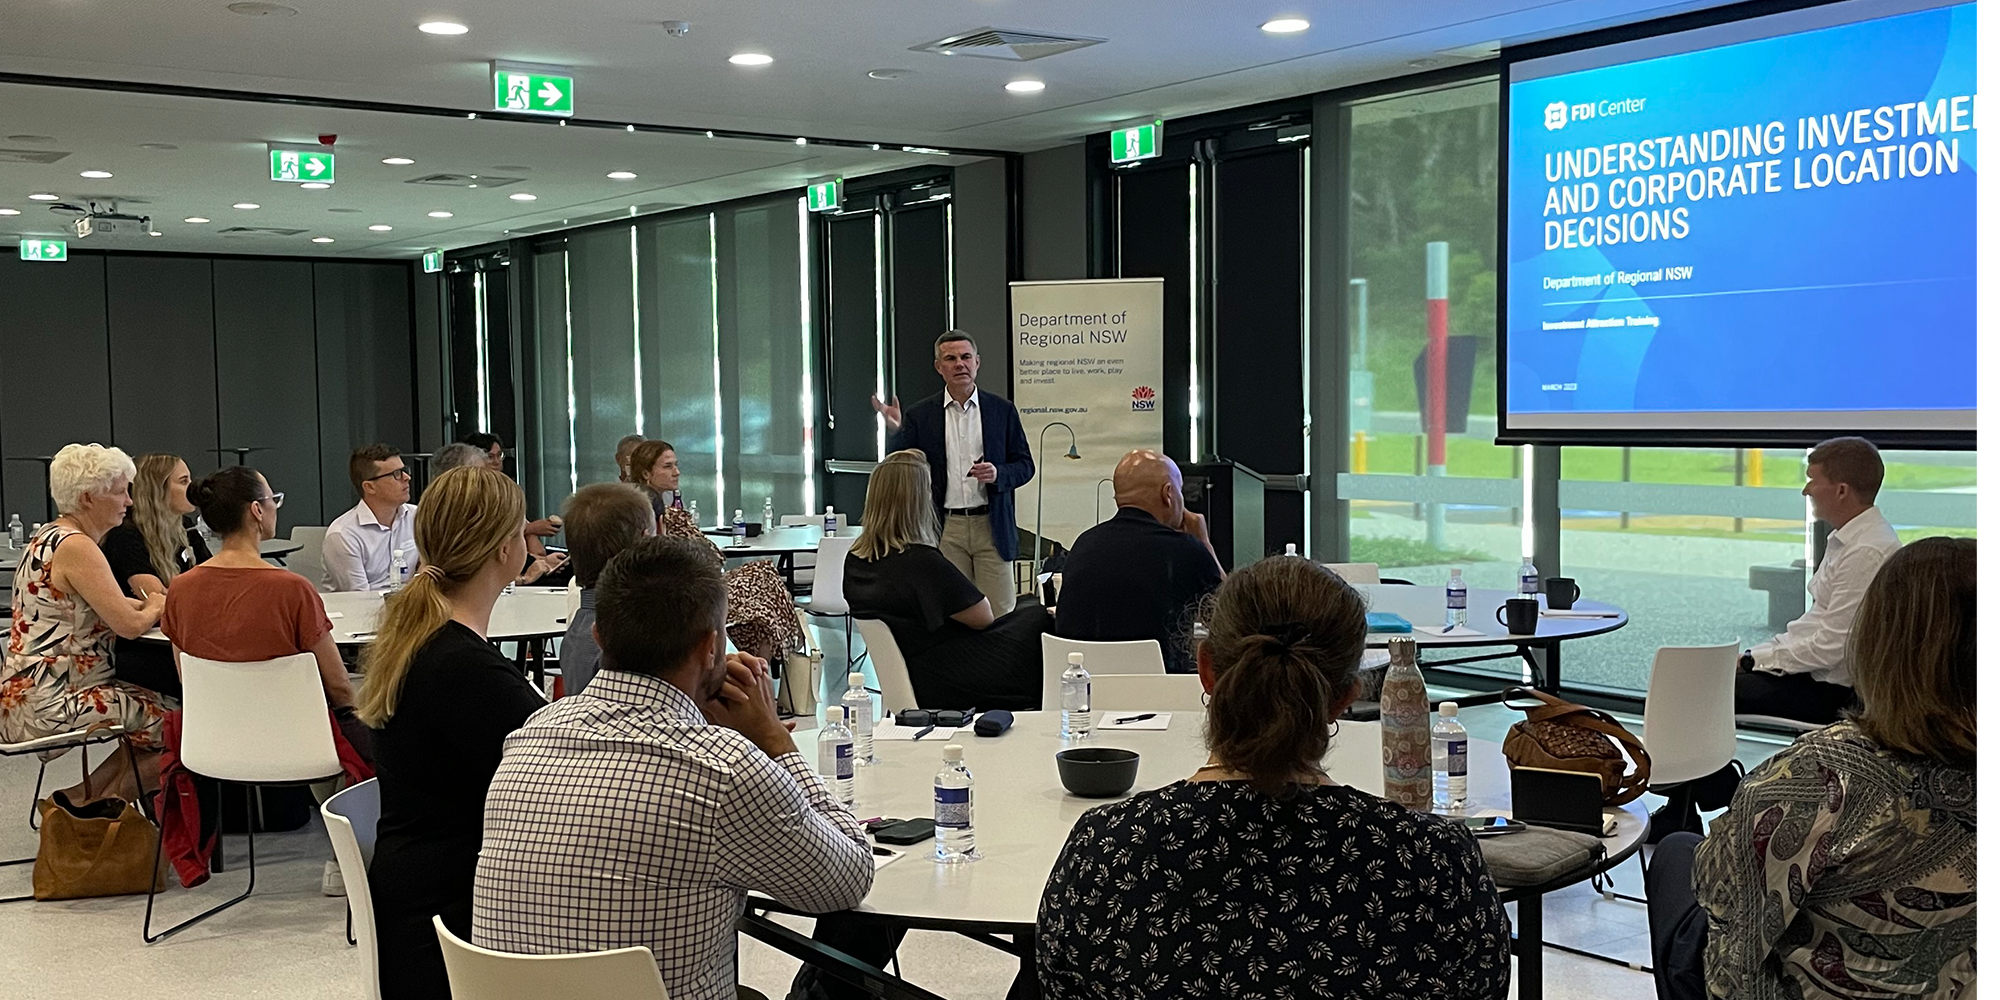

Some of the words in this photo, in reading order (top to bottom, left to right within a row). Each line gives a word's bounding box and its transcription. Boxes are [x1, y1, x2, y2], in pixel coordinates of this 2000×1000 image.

[1571, 102, 1595, 121] FDI
[1598, 98, 1646, 117] Center
[1545, 121, 1785, 182] UNDERSTANDING
[1798, 94, 1977, 151] INVESTME
[1543, 182, 1599, 217] AND
[1608, 160, 1782, 210] CORPORATE
[1793, 138, 1959, 190] LOCATION
[1544, 207, 1690, 250] DECISIONS
[1543, 274, 1601, 291] Department
[1604, 271, 1615, 285] of
[1618, 268, 1662, 286] Regional
[1665, 266, 1693, 280] NSW
[1020, 312, 1107, 328] Department
[1112, 310, 1127, 324] of
[1542, 320, 1585, 330] Investment
[1586, 317, 1625, 328] Attraction
[1626, 315, 1660, 328] Training
[1020, 331, 1084, 348] Regional
[1090, 330, 1128, 344] NSW
[1020, 359, 1044, 367] Making
[1046, 358, 1076, 366] regional
[1042, 368, 1061, 376] place
[1020, 406, 1088, 414] regional.nsw.gov.au
[1132, 400, 1155, 408] NSW
